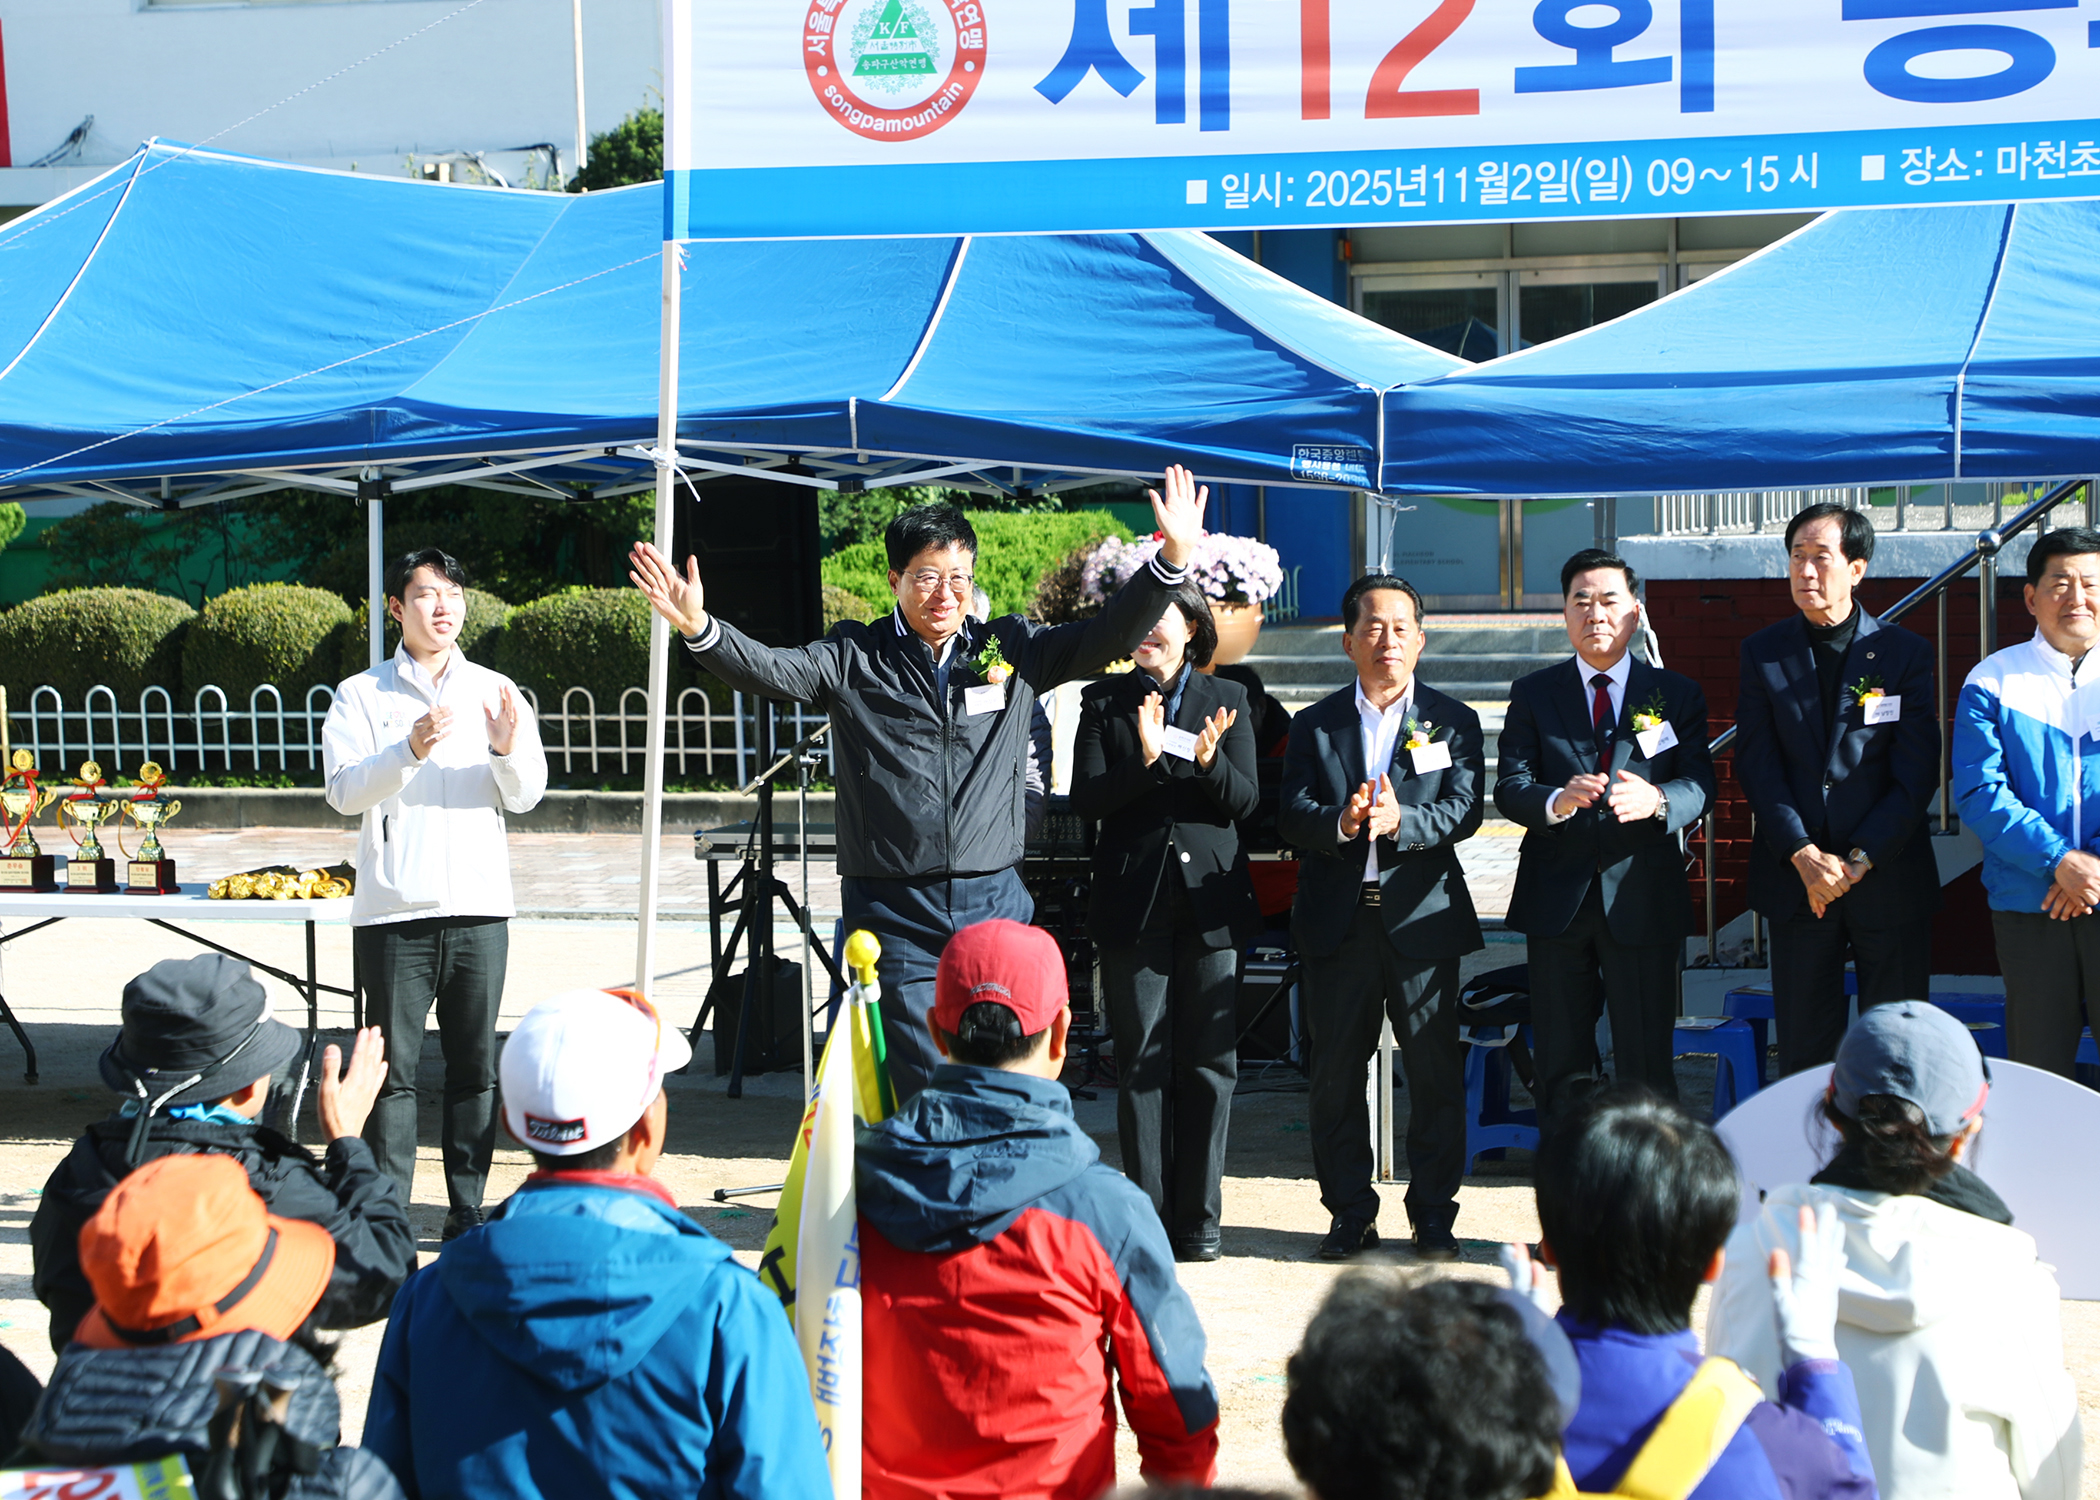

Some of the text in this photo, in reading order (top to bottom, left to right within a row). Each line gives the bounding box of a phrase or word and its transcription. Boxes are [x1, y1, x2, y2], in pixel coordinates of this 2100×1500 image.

[879, 21, 910, 34] K F
[861, 57, 927, 70] 송파구산악연맹
[824, 82, 964, 132] songpamountain
[1221, 171, 1294, 209] 일시:
[1900, 146, 1983, 186] 장소:
[1997, 140, 2100, 181] 마천초
